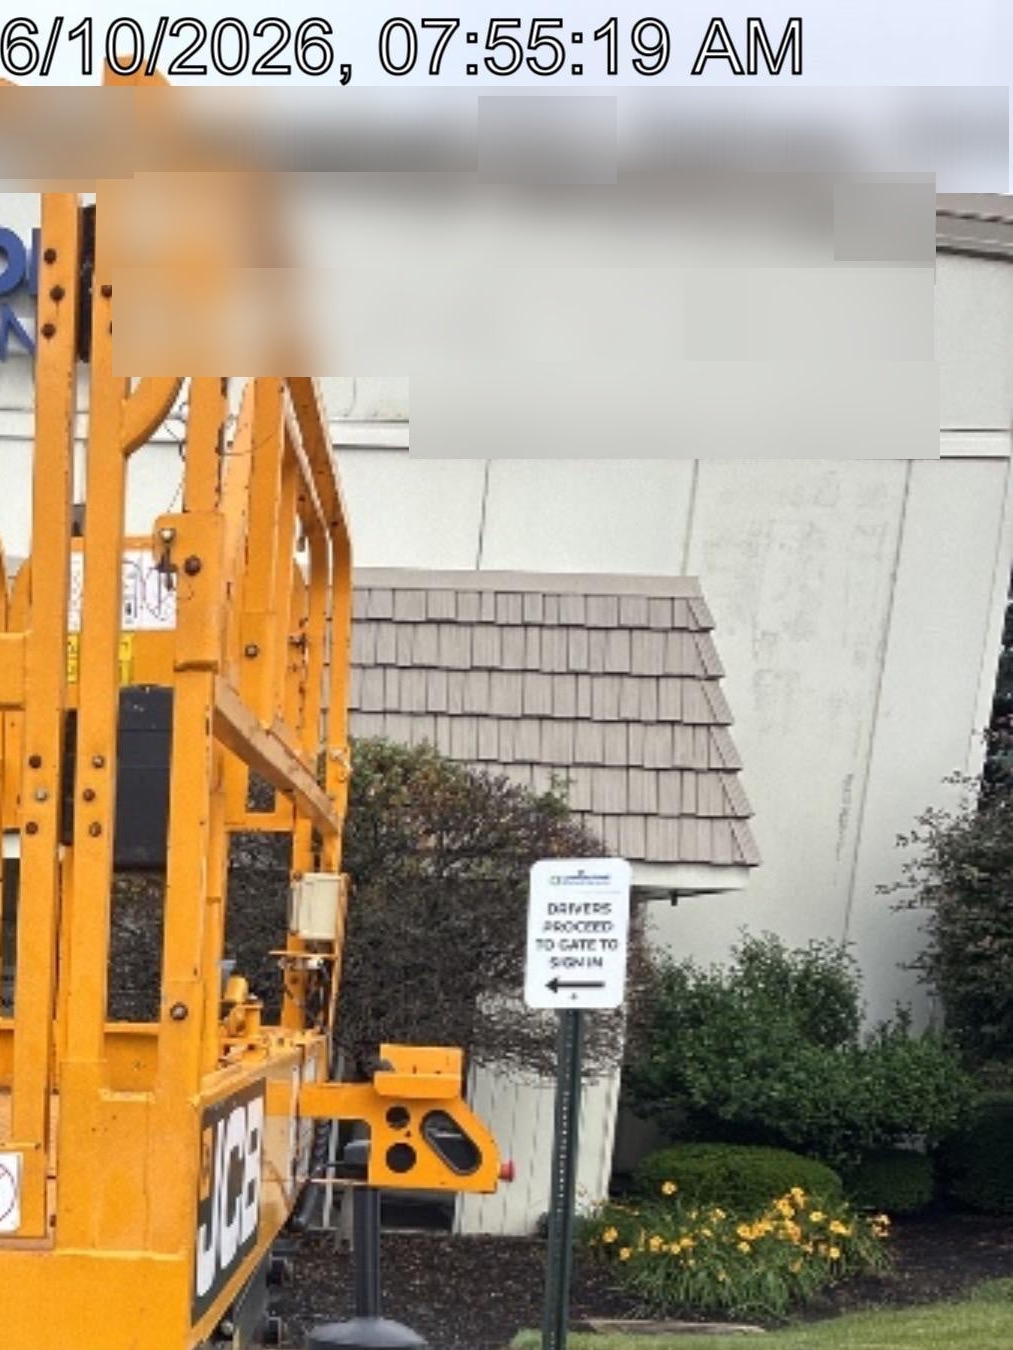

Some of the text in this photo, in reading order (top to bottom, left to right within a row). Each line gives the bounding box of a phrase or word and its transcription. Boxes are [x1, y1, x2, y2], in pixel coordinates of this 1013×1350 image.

[547, 902, 612, 916] DRIVERS
[543, 920, 614, 933] PROCEED
[535, 938, 619, 951] TO GATE TO
[549, 956, 603, 969] SIGN IN
[196, 1096, 264, 1297] JCB
